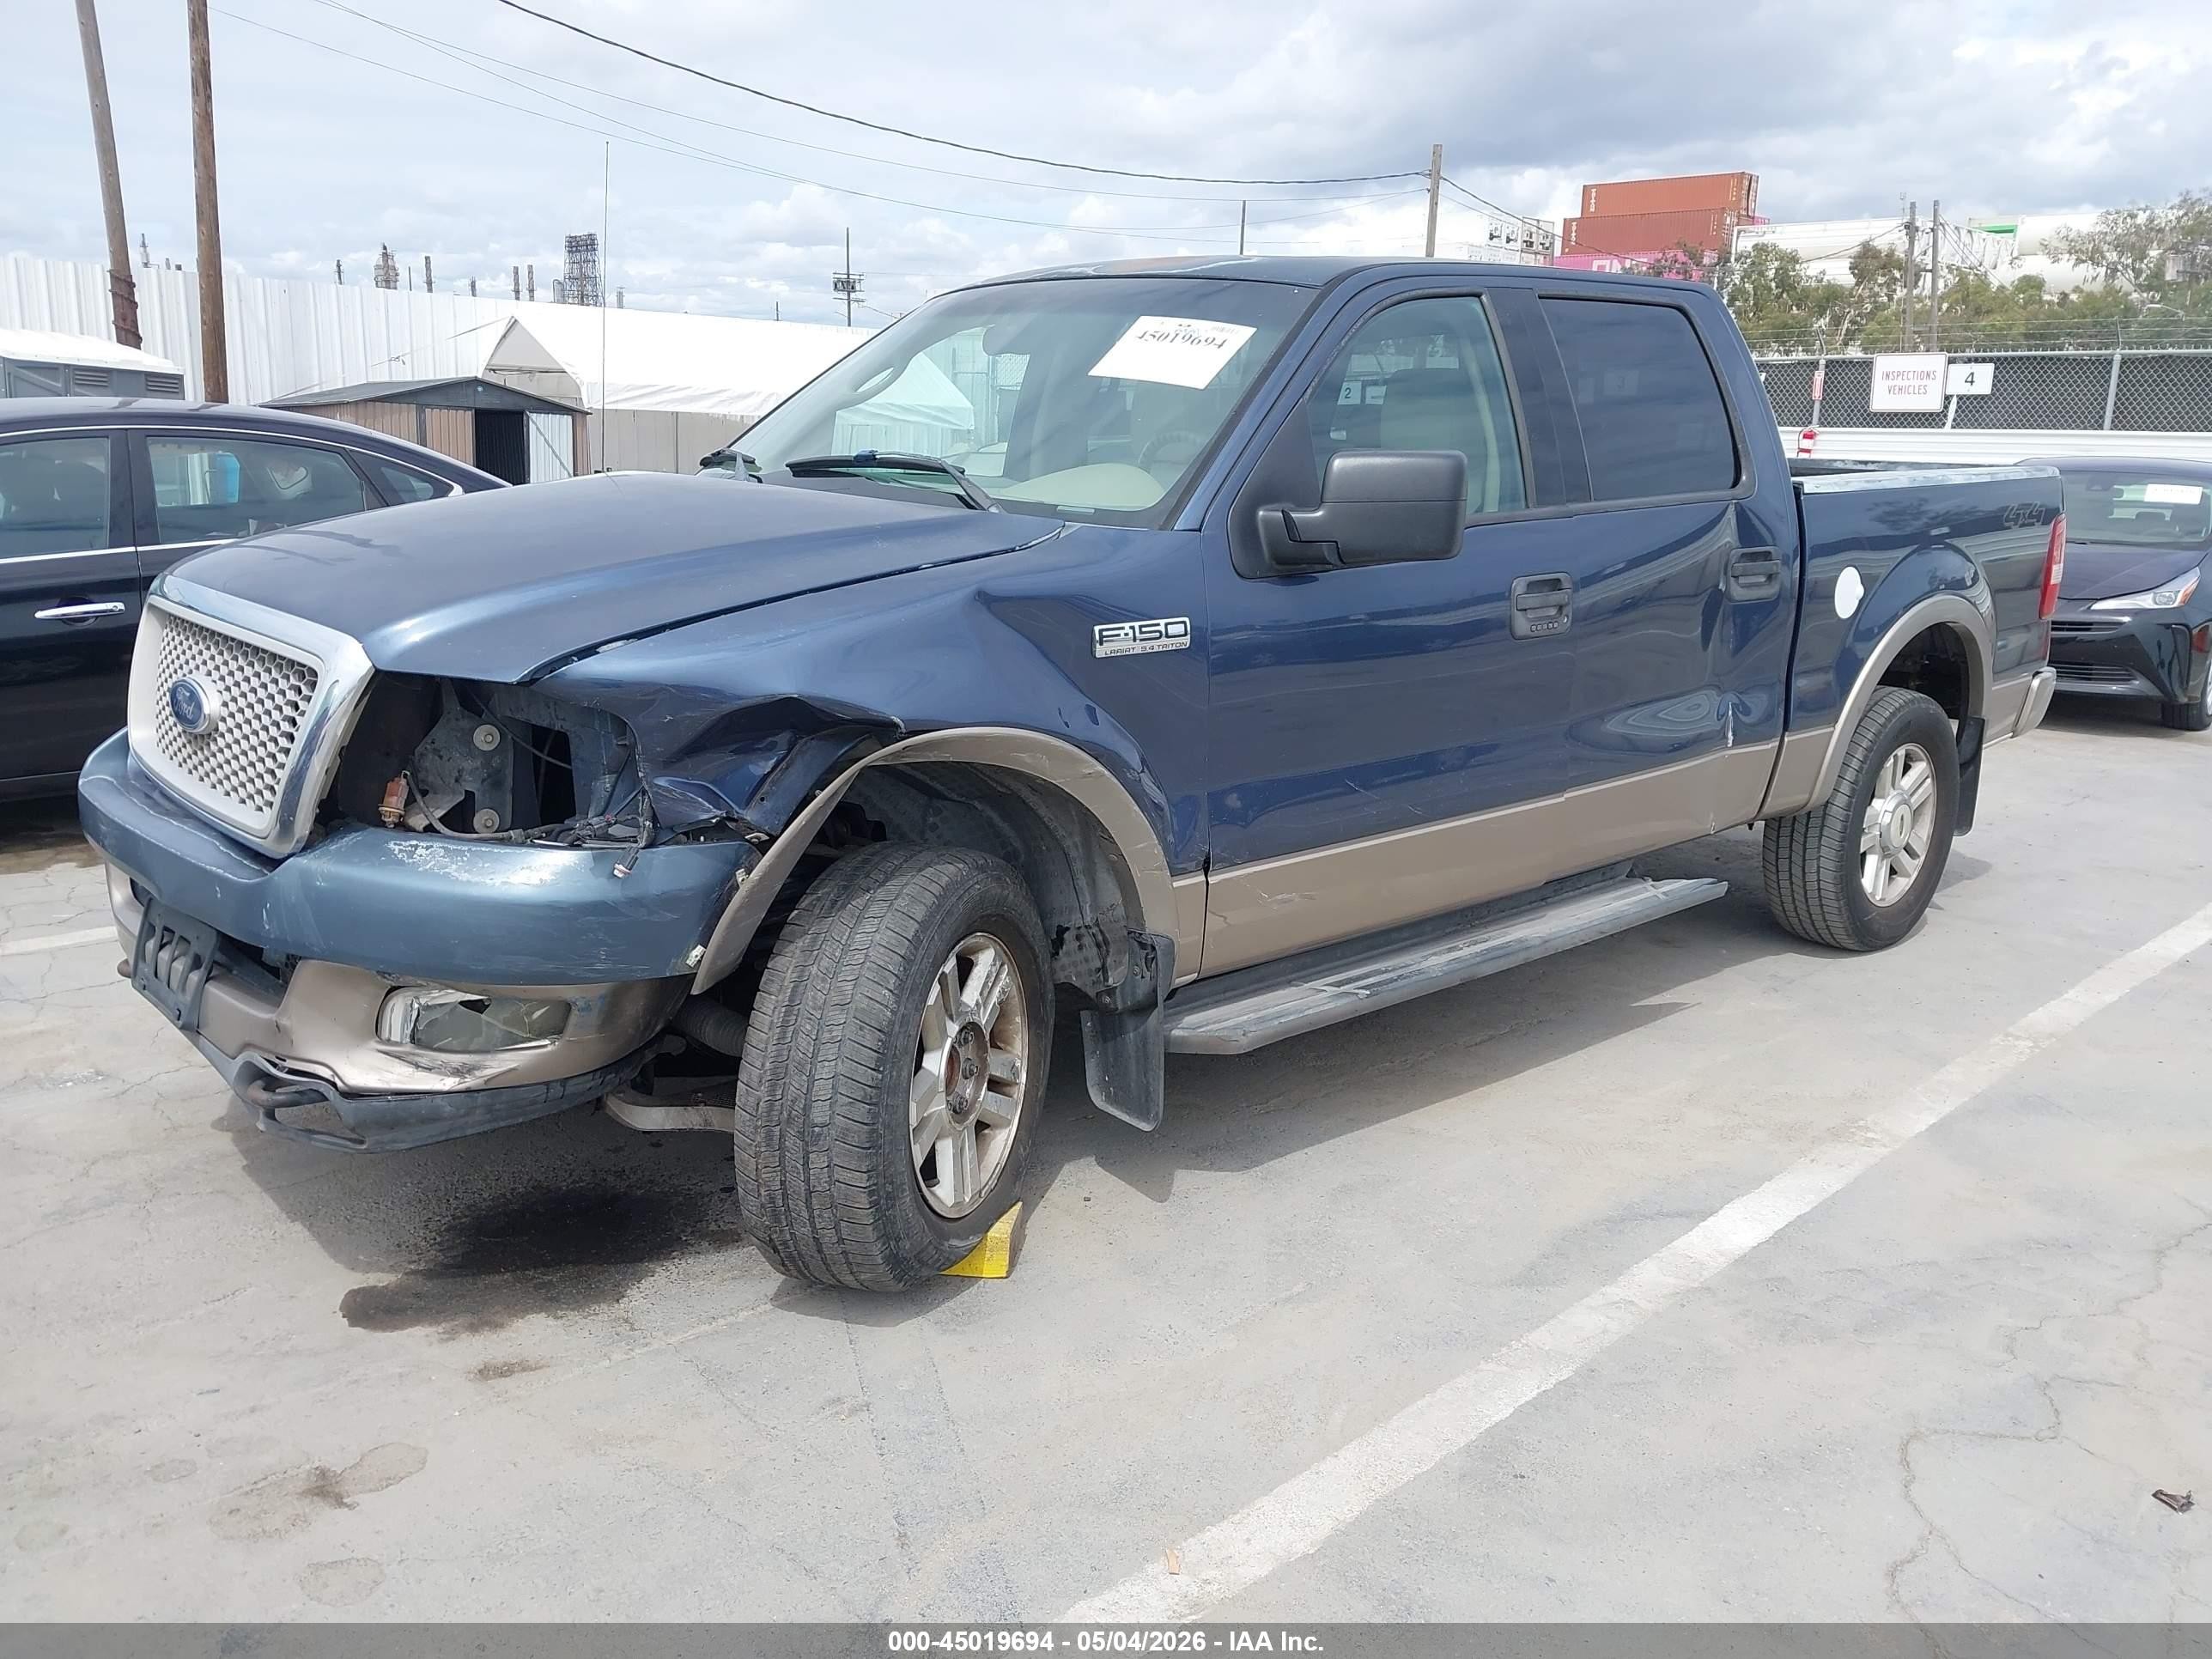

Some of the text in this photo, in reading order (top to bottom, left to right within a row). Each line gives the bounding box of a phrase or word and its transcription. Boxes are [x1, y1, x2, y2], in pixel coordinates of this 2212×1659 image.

[1136, 330, 1229, 349] 45019694
[1881, 370, 1937, 380] INSPECTIONS
[1964, 372, 1976, 386] 4
[1345, 387, 1352, 399] 2
[1887, 384, 1929, 395] VEHICLES
[1104, 647, 1137, 656] LARIAT
[1156, 641, 1188, 651] TRITON
[173, 686, 196, 720] Ford
